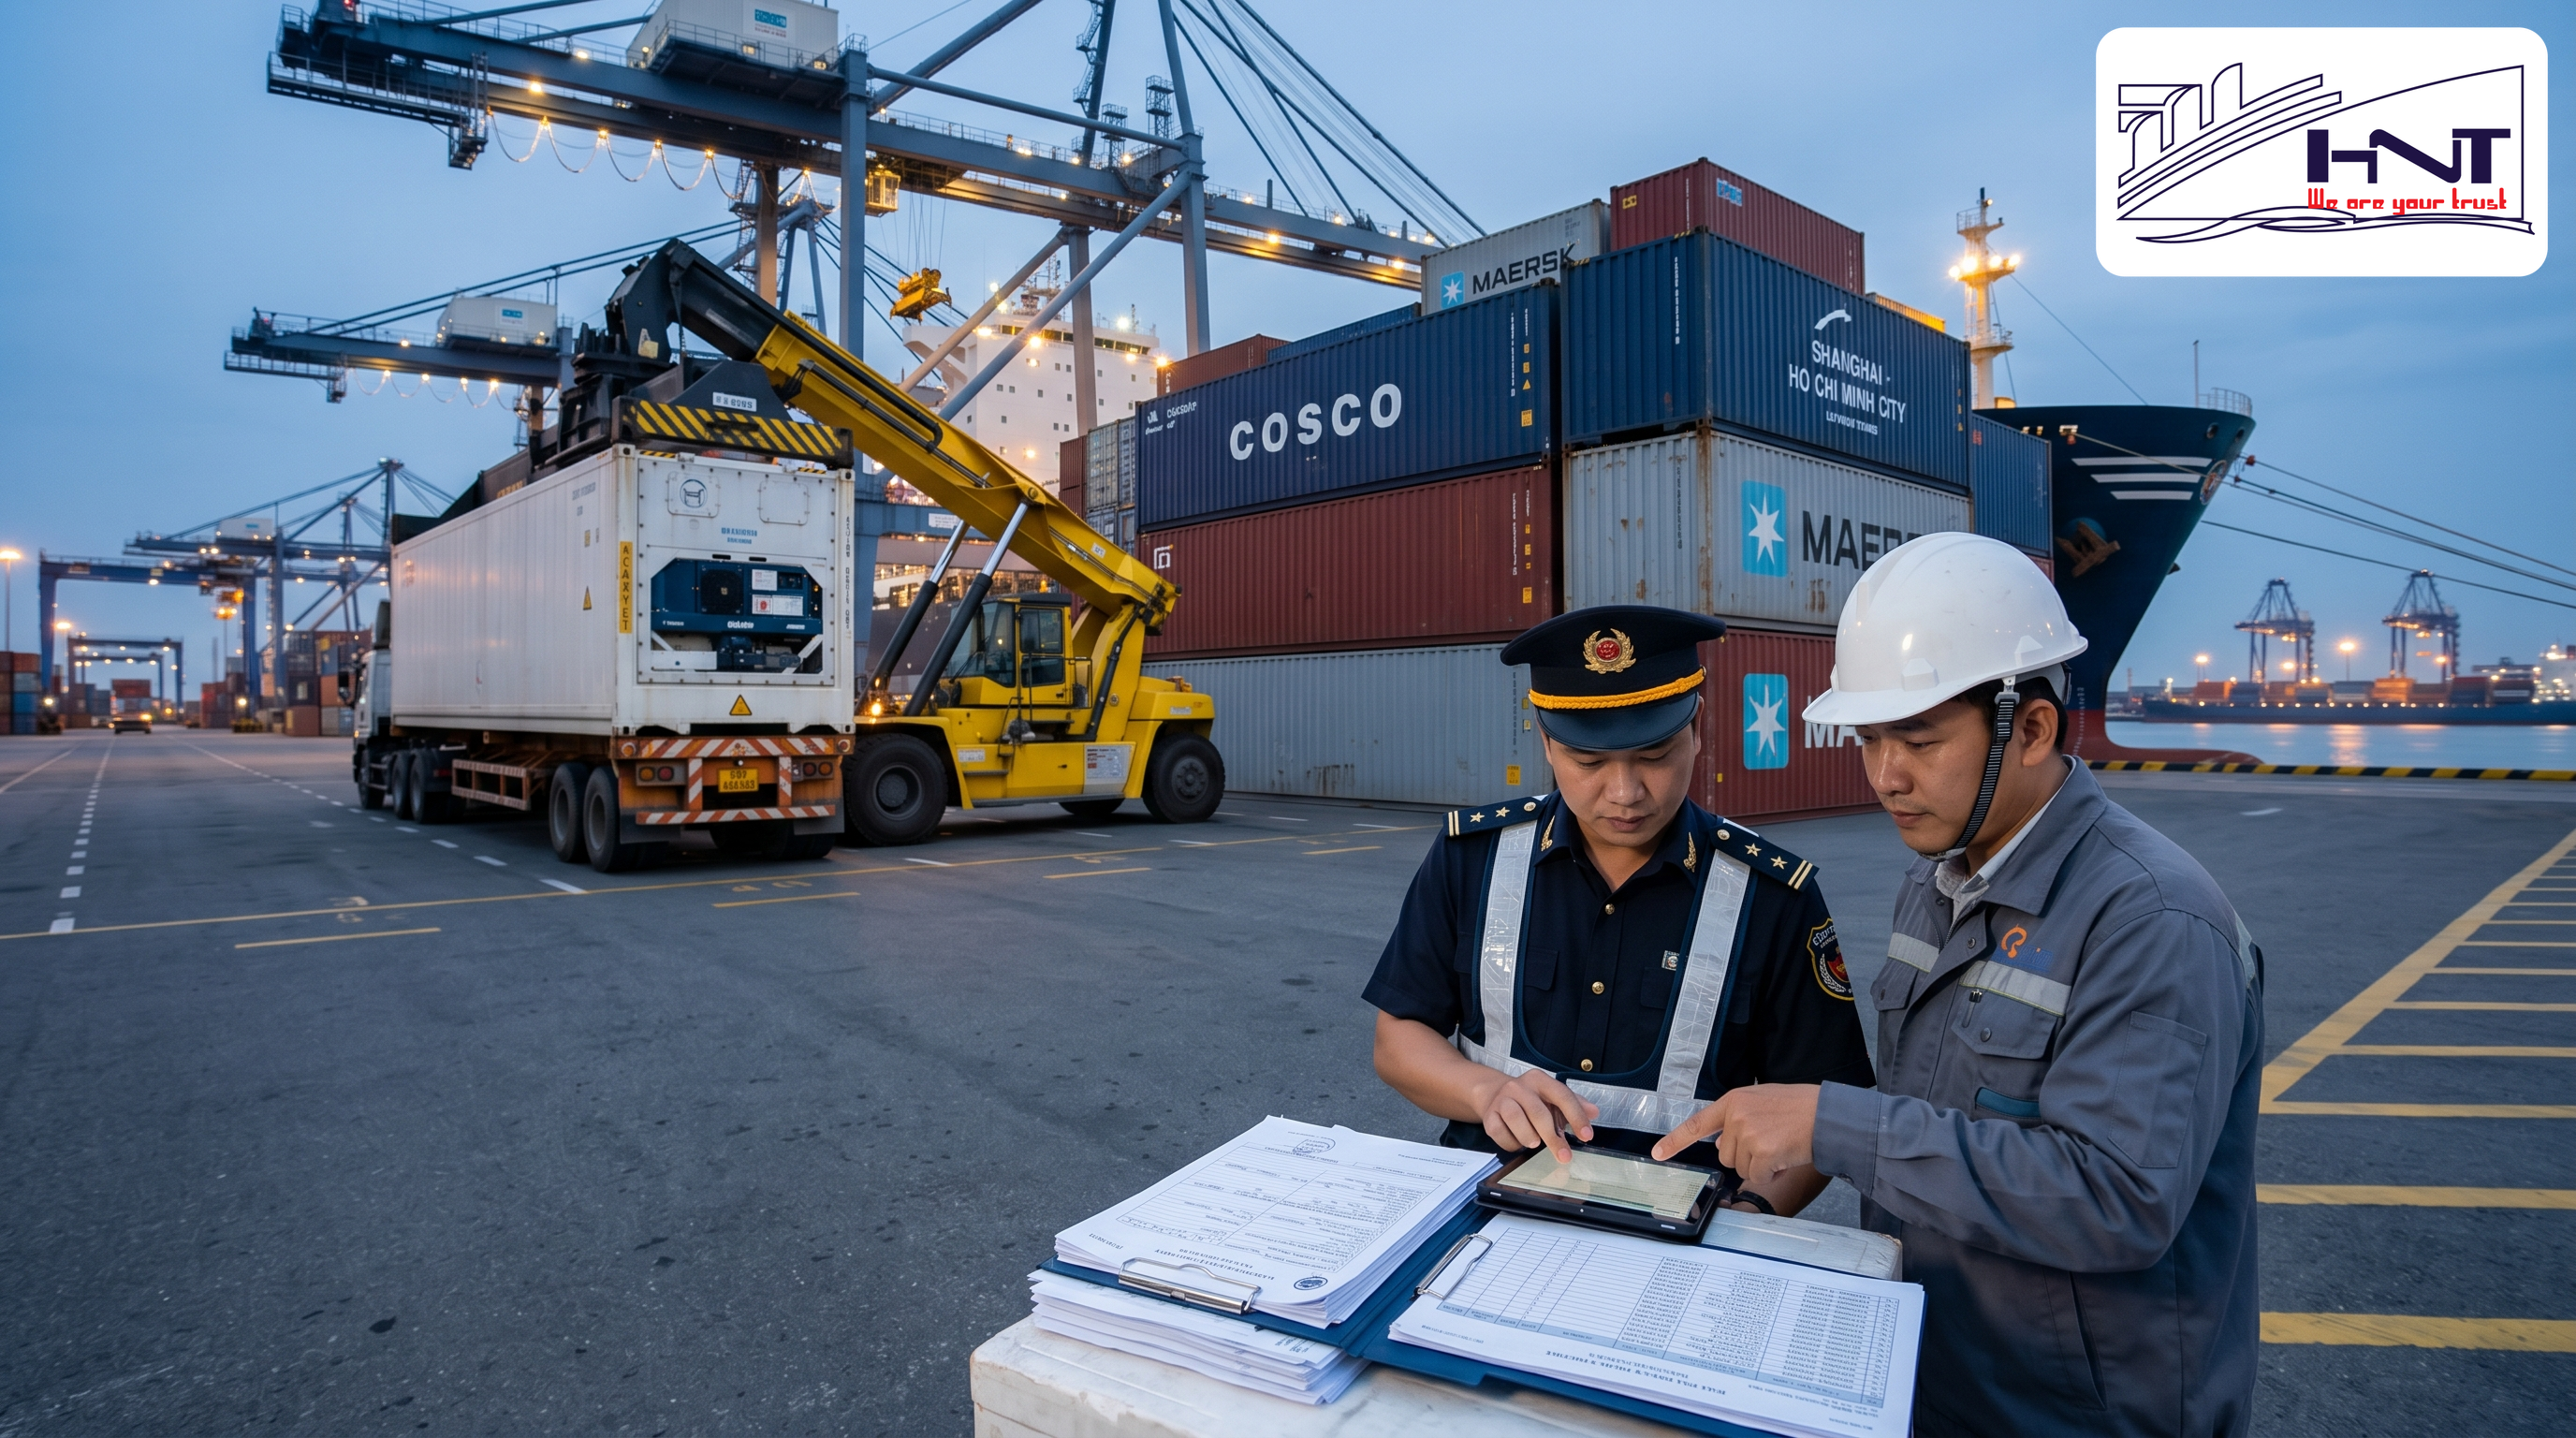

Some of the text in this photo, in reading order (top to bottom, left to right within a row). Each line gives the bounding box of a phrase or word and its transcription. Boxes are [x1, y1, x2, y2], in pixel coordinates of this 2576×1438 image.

[1472, 243, 1575, 295] MAERSK
[1789, 363, 1810, 392] HO
[1814, 374, 1837, 402] CHI
[1841, 382, 1875, 414] MINH
[1879, 395, 1906, 423] CITY
[1812, 340, 1882, 386] SHANGHAI
[1229, 383, 1402, 461] COSCO
[1802, 510, 1924, 571] MAE
